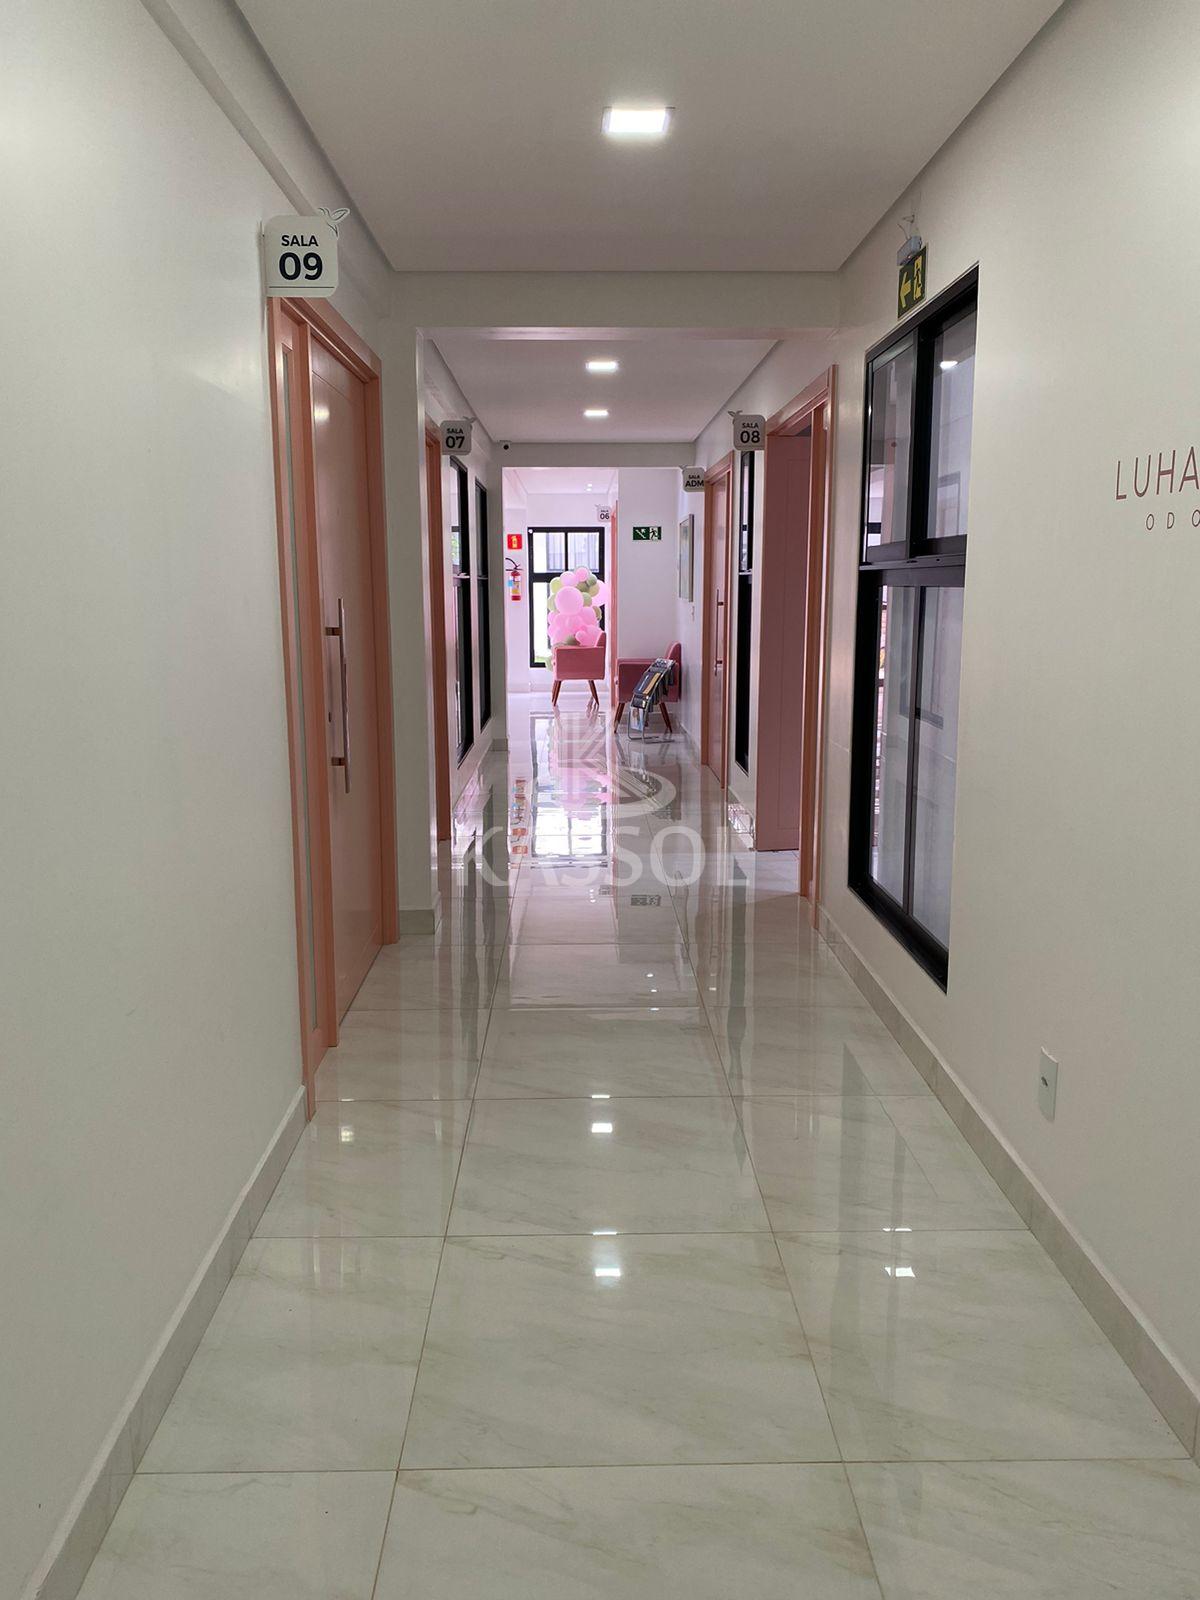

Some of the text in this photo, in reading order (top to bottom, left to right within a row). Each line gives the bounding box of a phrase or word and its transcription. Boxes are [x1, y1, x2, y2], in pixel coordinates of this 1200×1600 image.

[281, 234, 319, 247] SALA
[279, 252, 323, 280] 09
[445, 435, 465, 449] 07
[740, 430, 760, 443] 08
[1115, 446, 1200, 500] LUHA
[685, 479, 704, 488] ADM
[600, 512, 610, 520] 06
[1146, 509, 1200, 531] ODO
